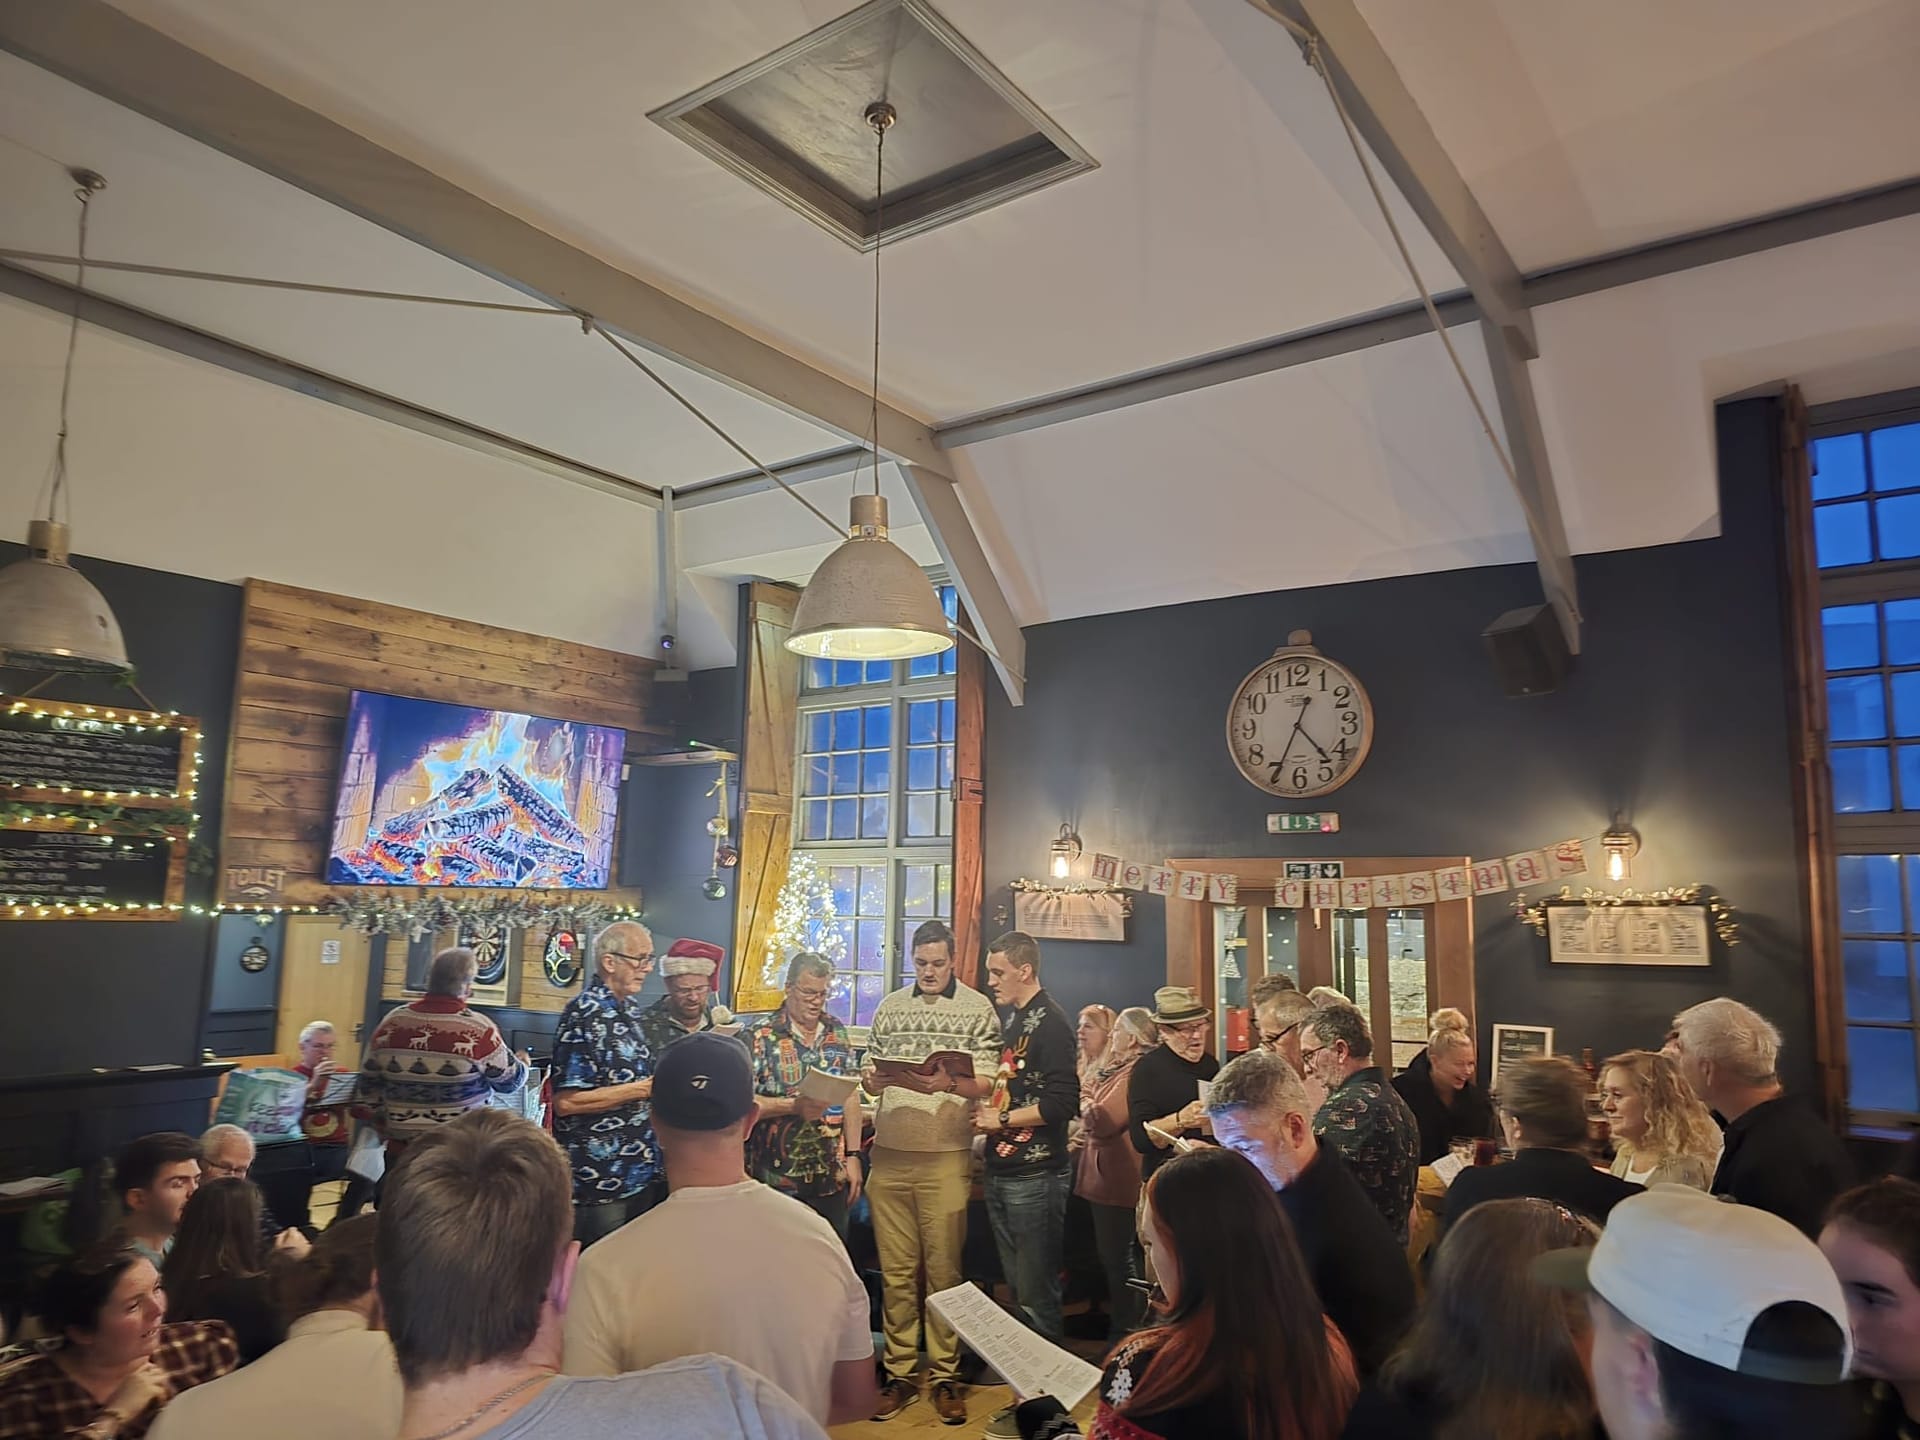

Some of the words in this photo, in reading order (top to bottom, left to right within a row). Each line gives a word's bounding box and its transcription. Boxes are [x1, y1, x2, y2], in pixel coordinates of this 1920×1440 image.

[1265, 671, 1280, 694] 11
[1286, 664, 1310, 687] 12
[1318, 669, 1328, 691] 1
[1246, 691, 1266, 715] 10
[1333, 685, 1350, 709] 2
[1242, 718, 1256, 740] 9
[1341, 711, 1358, 735] 3
[1248, 743, 1264, 766] 8
[1331, 738, 1350, 761] 4
[1267, 761, 1283, 784] 7
[1292, 766, 1307, 789] 6
[1318, 759, 1333, 782] 5
